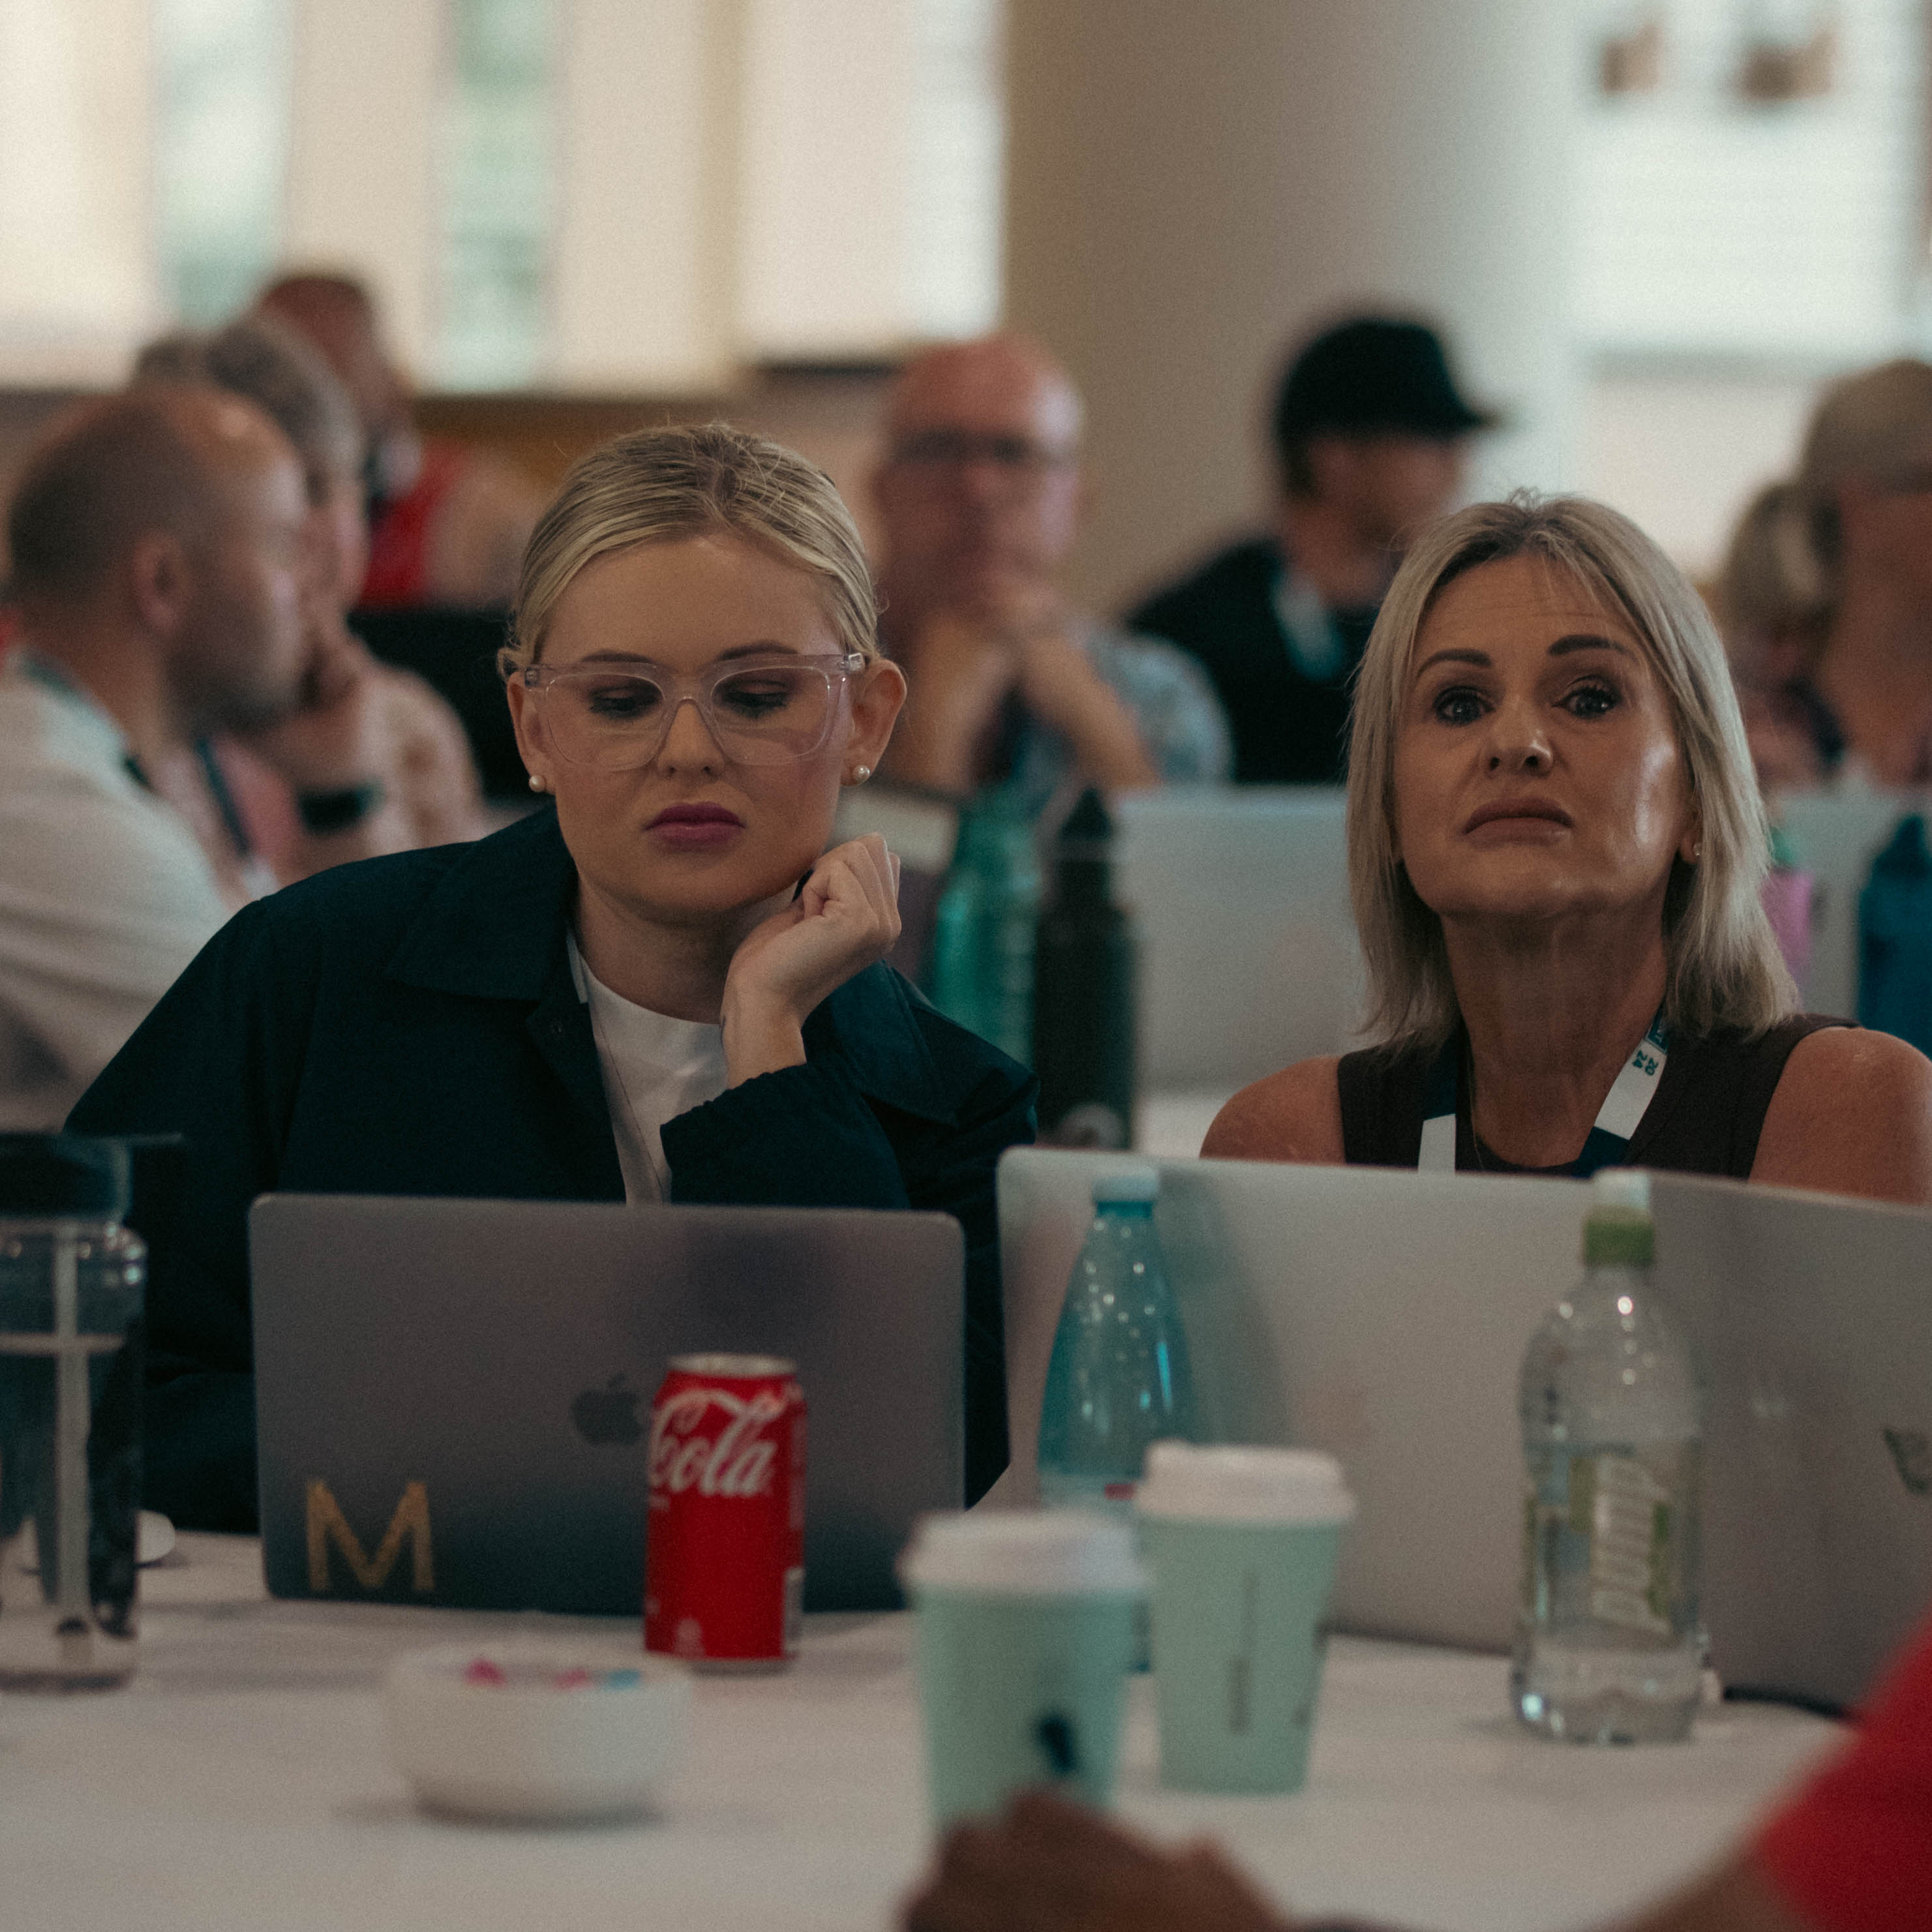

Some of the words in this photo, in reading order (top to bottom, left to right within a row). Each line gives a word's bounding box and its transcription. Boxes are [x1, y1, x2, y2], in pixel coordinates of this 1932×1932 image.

[1632, 1050, 1648, 1069] 24
[1644, 1057, 1659, 1076] 20
[305, 1479, 435, 1591] M
